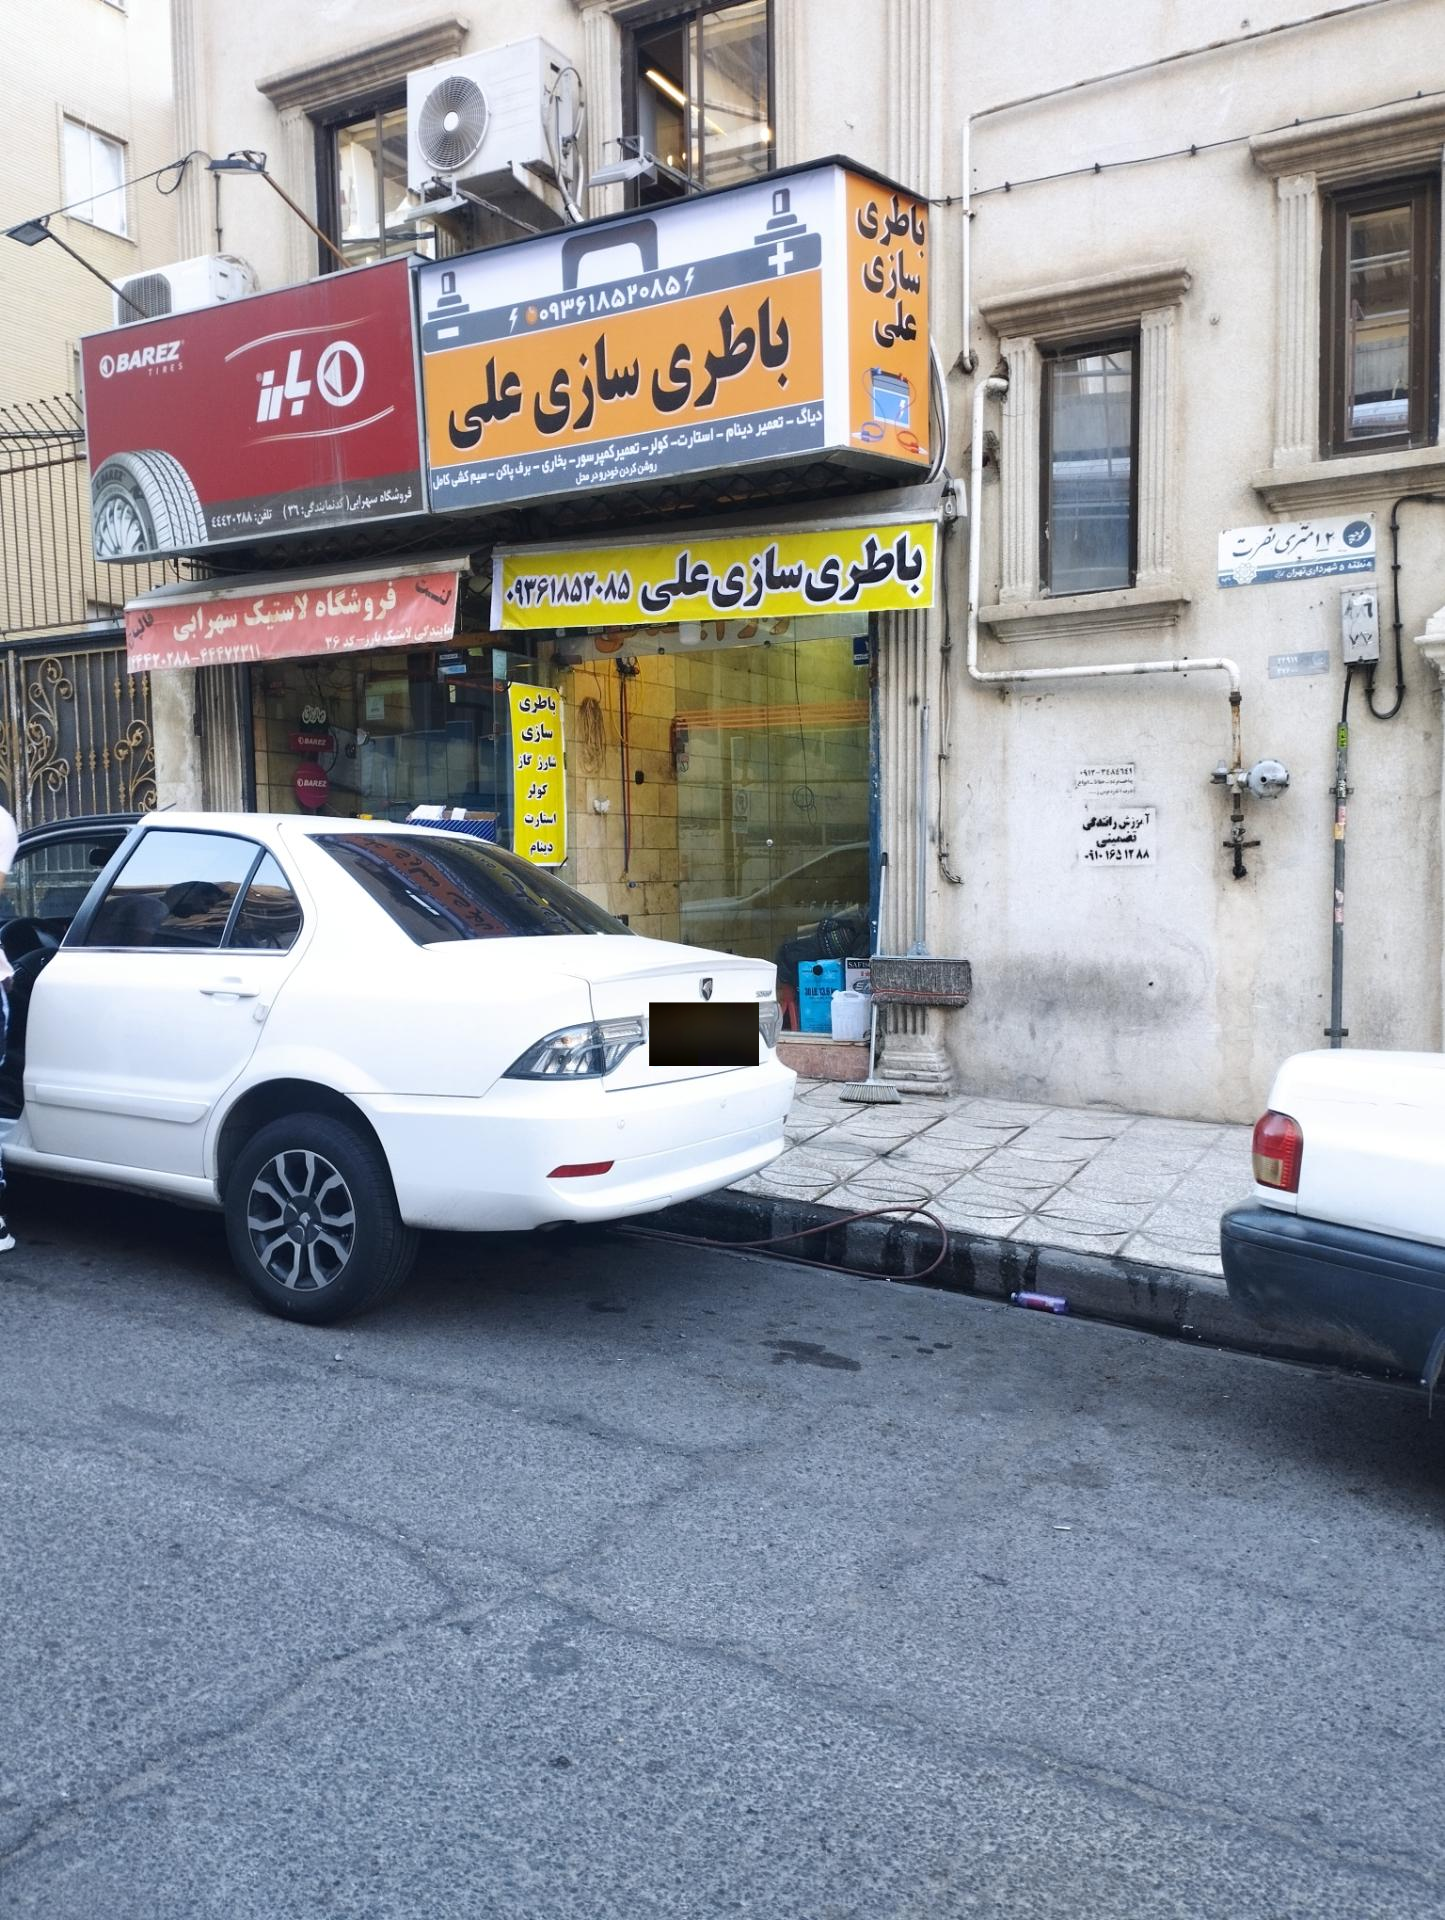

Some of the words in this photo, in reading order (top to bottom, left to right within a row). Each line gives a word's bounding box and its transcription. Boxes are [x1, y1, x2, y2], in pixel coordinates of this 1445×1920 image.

[856, 193, 925, 258] باطری
[862, 248, 920, 300] سازی
[539, 275, 681, 321] ۰۹۳۶۱۸۵۲۰۸۵
[873, 299, 917, 348] علی
[116, 340, 181, 373] BAREZ
[652, 297, 790, 411] باطری
[148, 362, 183, 376] TIRES
[533, 333, 640, 435] سازی
[448, 356, 522, 449] علی
[756, 416, 784, 437] تعمیر
[796, 407, 822, 427] دیاگ
[726, 422, 753, 442] دینام
[496, 464, 514, 482] پاکن
[515, 462, 531, 476] برف
[541, 455, 567, 474] بخاری
[433, 473, 450, 490] کامل
[451, 471, 469, 488] کشی
[470, 471, 487, 485] سیم
[380, 486, 413, 504] فروشگاه
[712, 544, 803, 607] سازی
[805, 532, 923, 602] باطری
[506, 572, 632, 608] ۰۹۳۶۱۸۵۲۰۸۵
[641, 552, 709, 612] علی
[244, 591, 310, 631] لاستیک
[315, 581, 397, 621] فروشگاه
[173, 606, 238, 642] سهرابی
[519, 694, 556, 715] باطری
[521, 723, 553, 742] سازی
[303, 779, 327, 787] BAREZ
[528, 783, 548, 799] کولر
[524, 812, 557, 828] استارت
[1083, 816, 1117, 831] رانندگی
[530, 840, 553, 857] دینام
[1096, 830, 1137, 848] تضمینی
